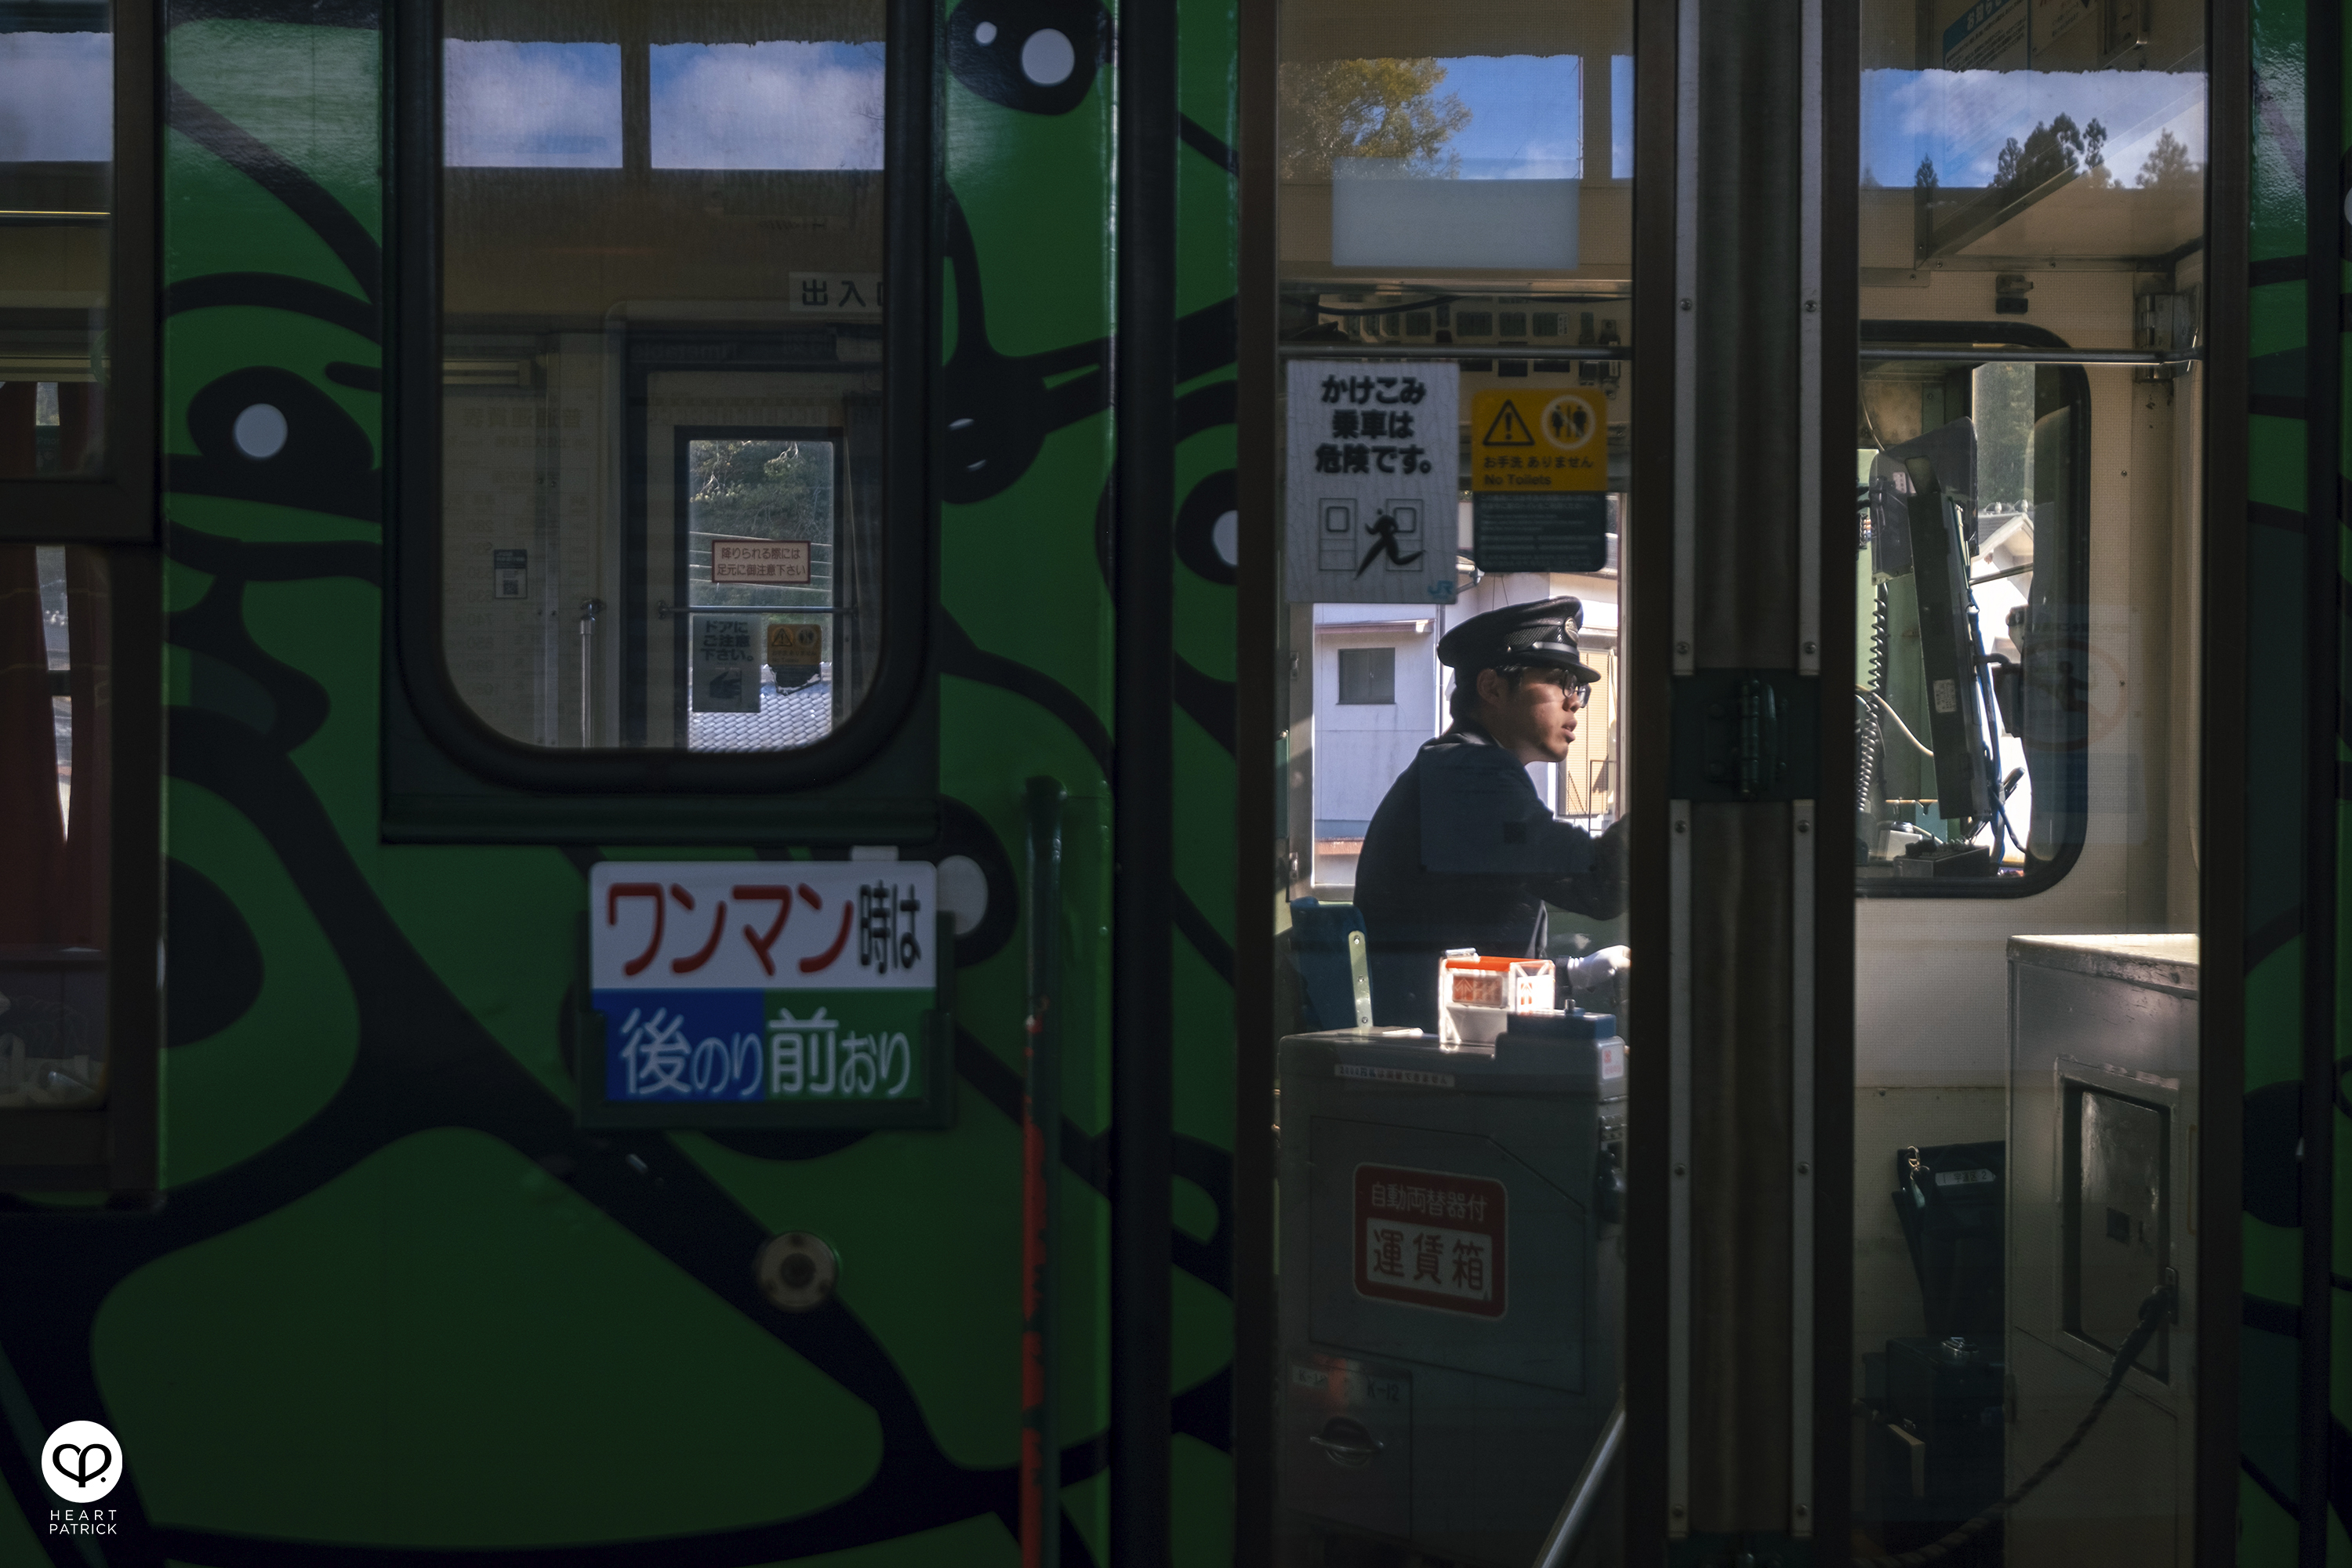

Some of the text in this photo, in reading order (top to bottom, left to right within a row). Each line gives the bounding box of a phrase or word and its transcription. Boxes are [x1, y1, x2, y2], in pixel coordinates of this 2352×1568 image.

[803, 279, 883, 307] 出入
[1321, 374, 1426, 405] かけこみ
[1332, 409, 1414, 439] 乗車は
[1316, 442, 1432, 474] 危険です。
[1527, 456, 1594, 468] ありません
[1484, 474, 1552, 485] No Toilets
[721, 547, 800, 560] 降りられる際には
[717, 564, 806, 576] 足元に御注意下さい
[1428, 580, 1453, 594] JR
[706, 620, 748, 633] ドアに
[703, 634, 750, 647] ご注意
[608, 879, 921, 976] ワンマン時は
[1372, 1181, 1487, 1221] 自動両替器付
[1374, 1228, 1484, 1291] 運賃箱
[1367, 1377, 1400, 1402] K-12
